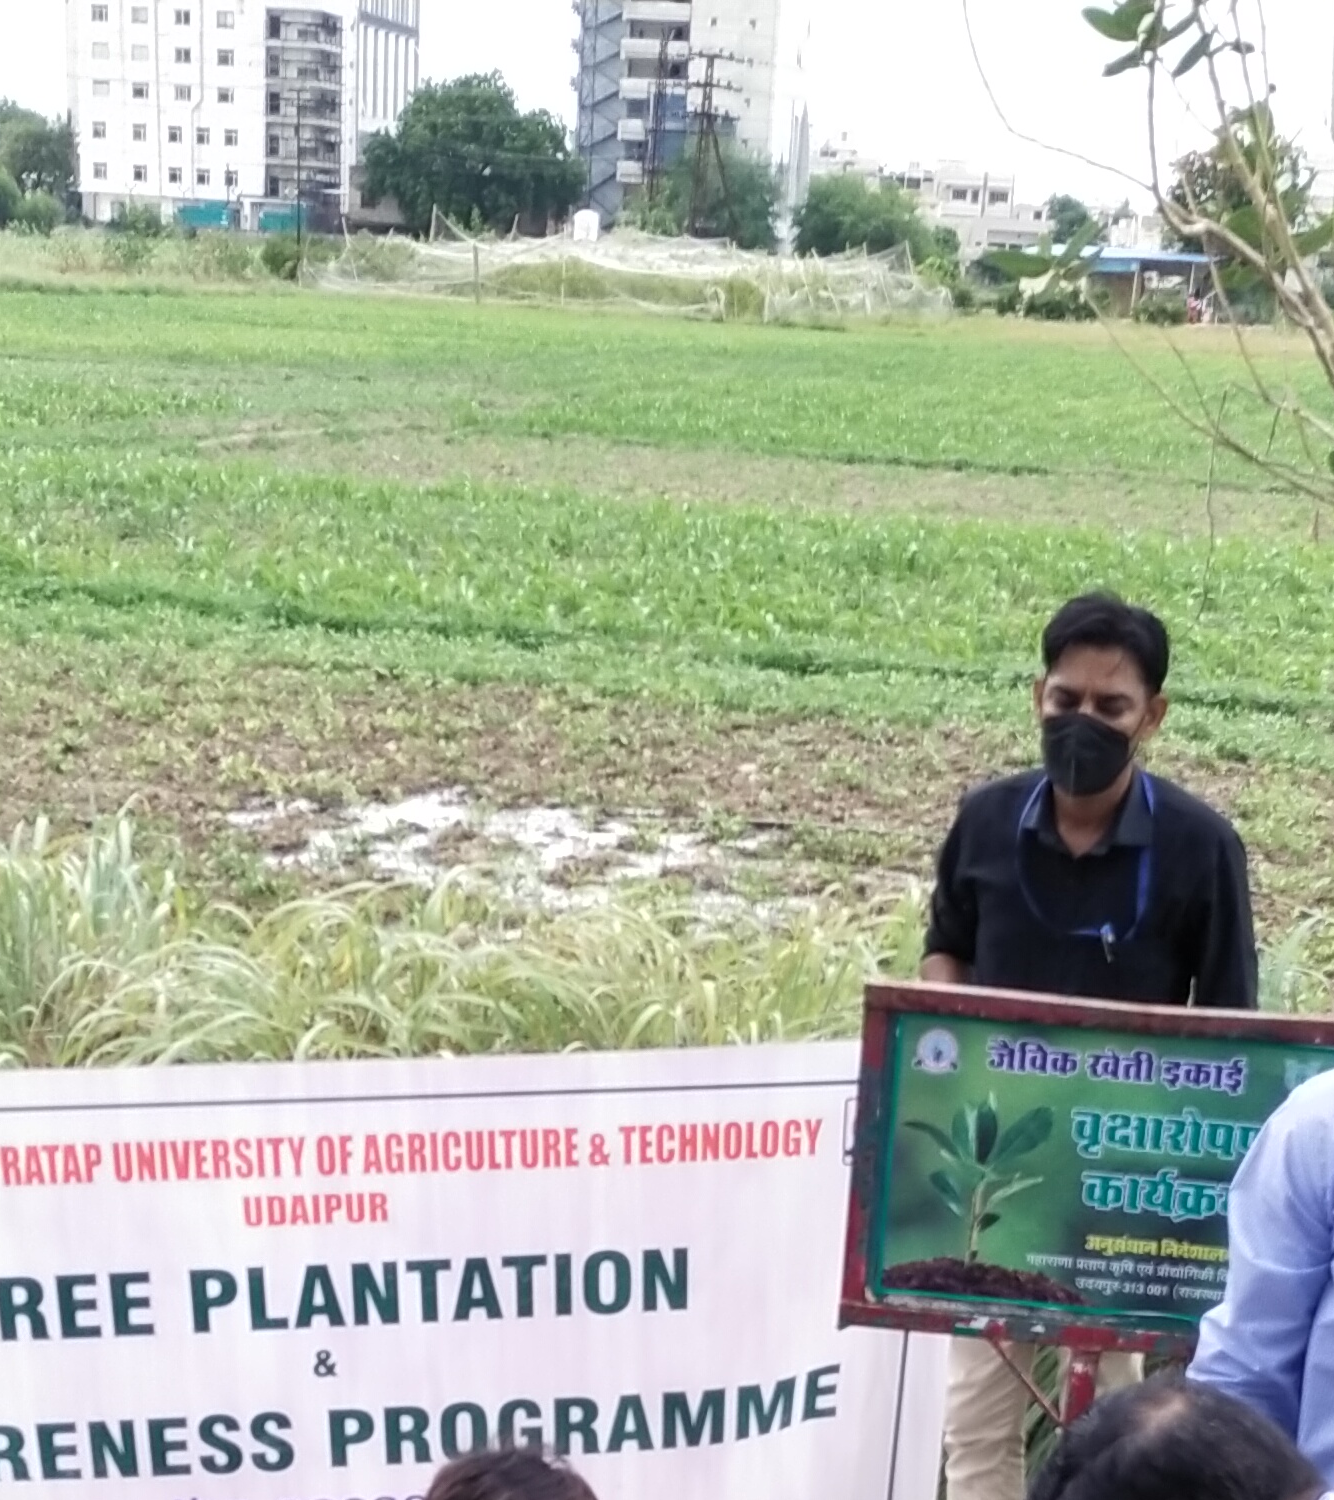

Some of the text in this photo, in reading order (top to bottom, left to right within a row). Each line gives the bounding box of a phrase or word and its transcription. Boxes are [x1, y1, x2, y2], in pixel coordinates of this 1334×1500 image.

[986, 1039, 1248, 1096] जैविक खेती इकाई
[112, 1135, 306, 1184] UNIVERSITY
[316, 1134, 355, 1177] OF
[363, 1127, 579, 1175] AGRICULTURE
[589, 1132, 611, 1167] &
[618, 1118, 824, 1165] TECHNOLOGY
[242, 1193, 389, 1228] UDAIPUR
[1081, 1167, 1230, 1221] कार्यक्र
[188, 1247, 689, 1334] PLANTATION
[313, 1350, 338, 1378] &
[328, 1363, 841, 1468] PROGRAMME
